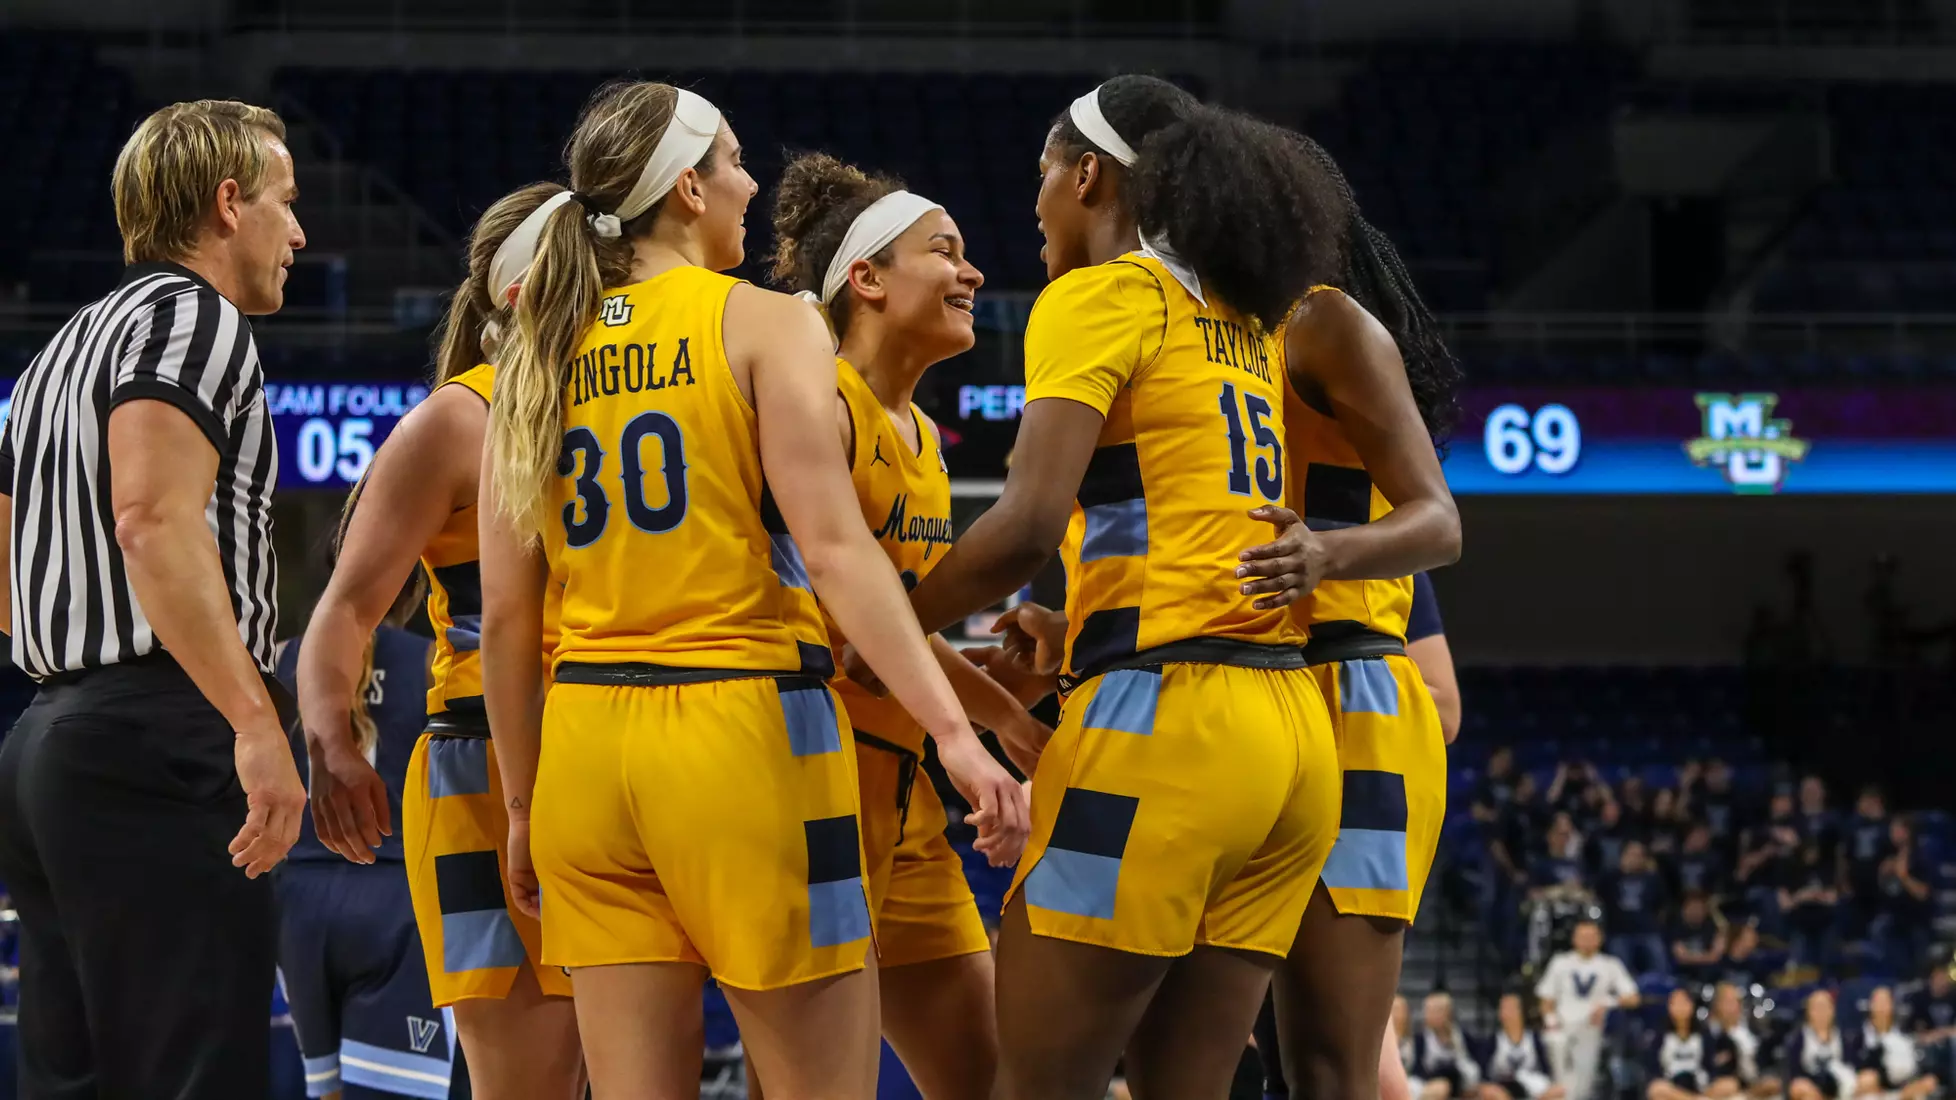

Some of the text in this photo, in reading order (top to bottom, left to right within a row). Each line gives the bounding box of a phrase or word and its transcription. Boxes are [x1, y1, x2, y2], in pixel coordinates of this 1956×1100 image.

[600, 294, 635, 327] MU
[1194, 316, 1272, 385] TAYLOR
[264, 383, 325, 416] EAM
[297, 417, 376, 483] 05
[1218, 380, 1284, 502] 15
[1484, 403, 1581, 475] 69
[556, 409, 690, 550] 30
[873, 493, 952, 561] Marque
[406, 1015, 440, 1053] V
